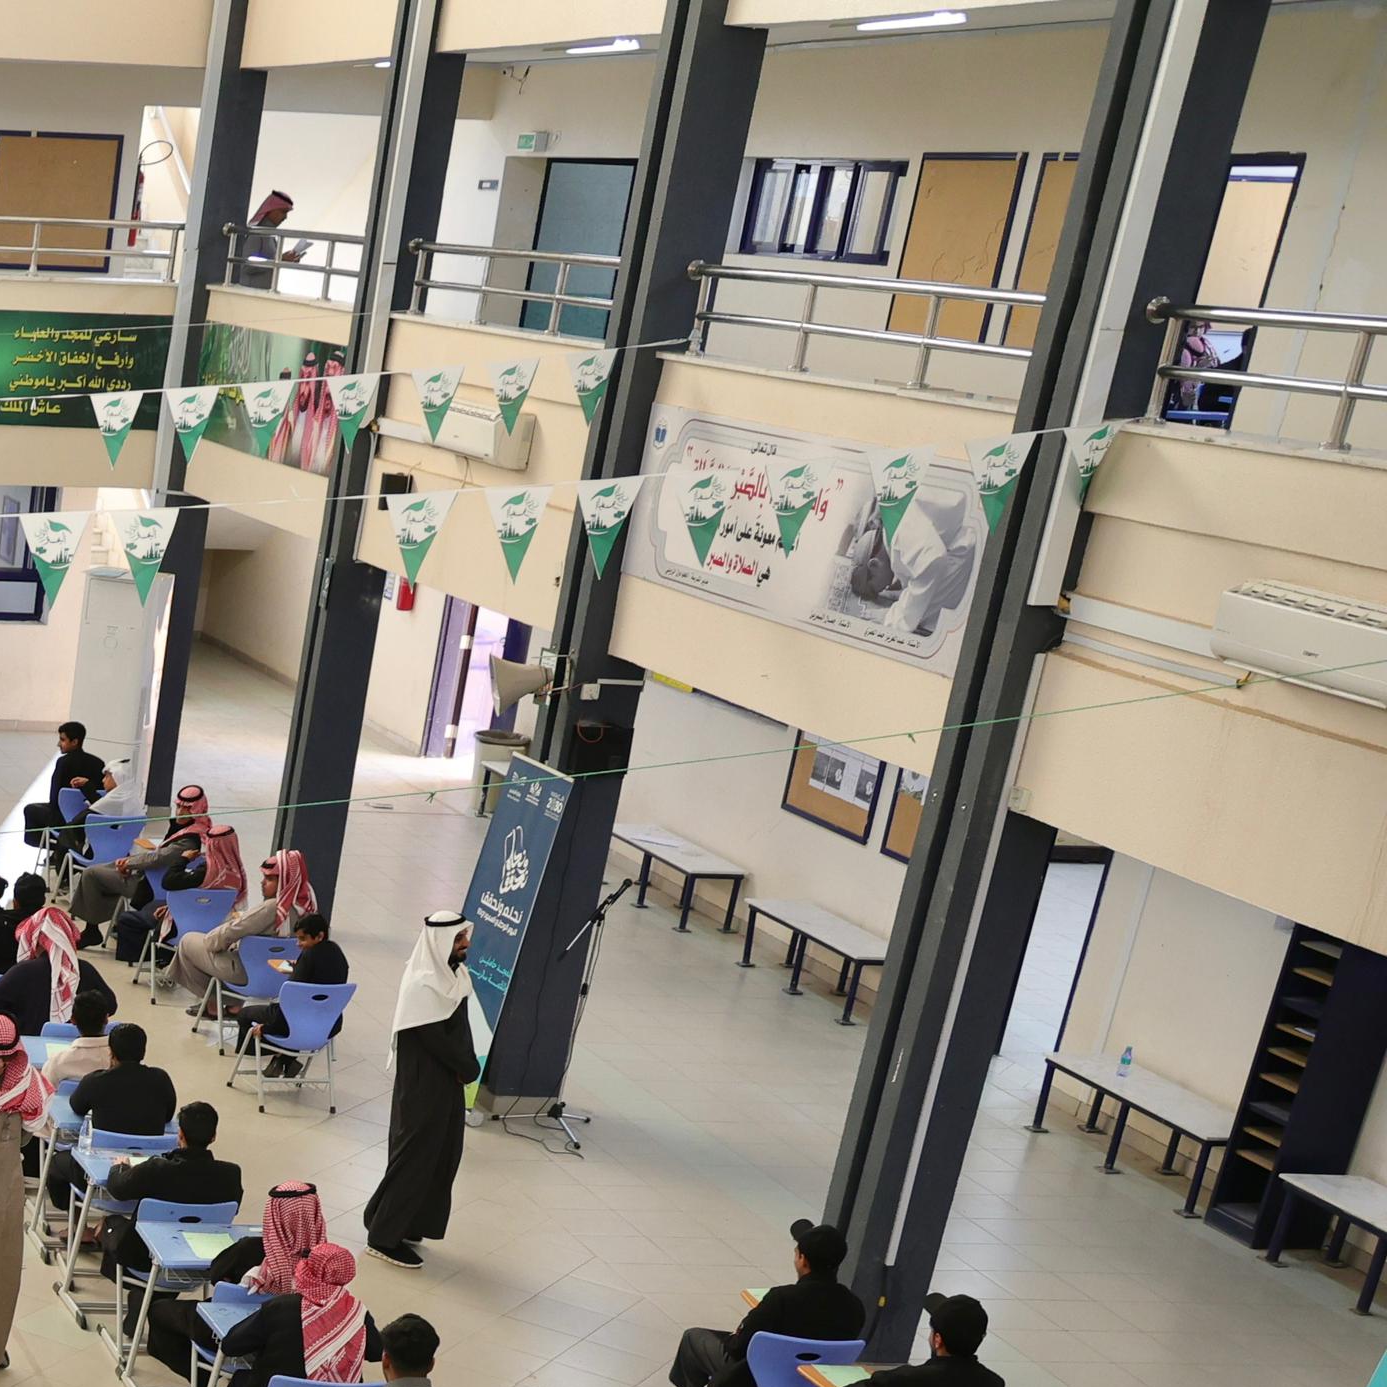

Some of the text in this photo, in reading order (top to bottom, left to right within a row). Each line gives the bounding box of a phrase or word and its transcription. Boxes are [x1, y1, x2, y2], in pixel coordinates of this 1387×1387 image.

[94, 330, 138, 346] سارعي
[58, 351, 94, 366] الخفاق
[57, 374, 86, 391] أكبر
[88, 375, 105, 389] الله
[707, 547, 732, 574] والصبر
[733, 553, 757, 576] الصلاة
